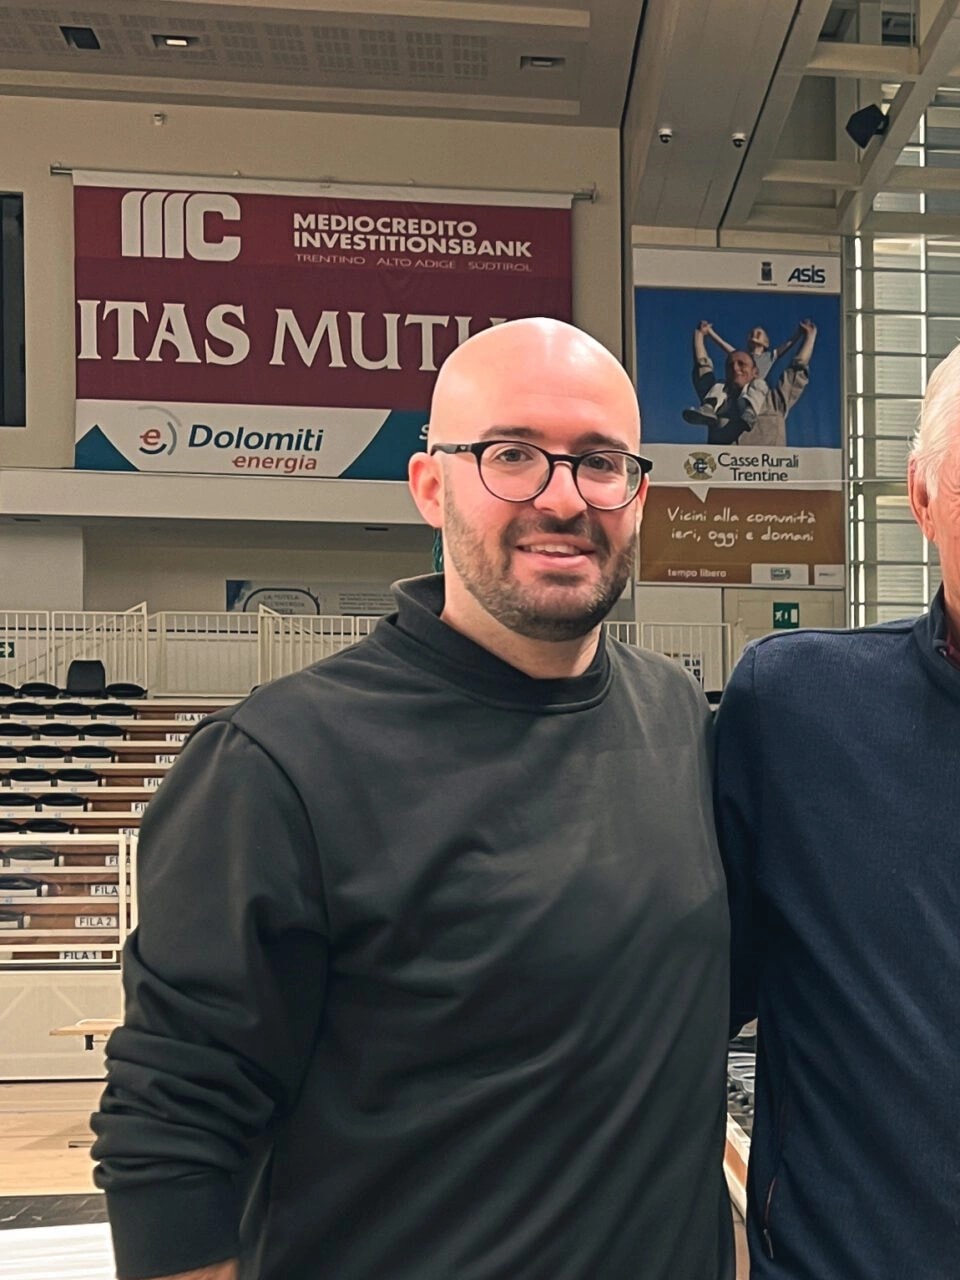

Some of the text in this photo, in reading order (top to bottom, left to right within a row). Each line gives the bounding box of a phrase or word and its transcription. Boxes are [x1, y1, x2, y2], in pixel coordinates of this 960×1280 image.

[293, 213, 478, 237] MEDIOCREDITO
[293, 231, 533, 258] INVESTITIONSBANK
[296, 253, 366, 265] TRENTINO
[376, 256, 412, 267] ALTO
[414, 258, 456, 269] ADIGE
[77, 299, 508, 372] ITAS MUT
[188, 424, 324, 452] Dolomiti
[232, 454, 317, 474] energia
[717, 452, 800, 468] Casse Rurali
[729, 467, 788, 482] Trentine
[667, 506, 816, 524] Vicini alla comunità
[671, 525, 814, 547] ieri, oggi e domani
[667, 567, 727, 578] tempo libero
[159, 755, 177, 763] FIL
[110, 856, 131, 865] FIA
[95, 885, 119, 895] FILA
[80, 917, 112, 926] FILA 2
[63, 951, 89, 960] FILA
